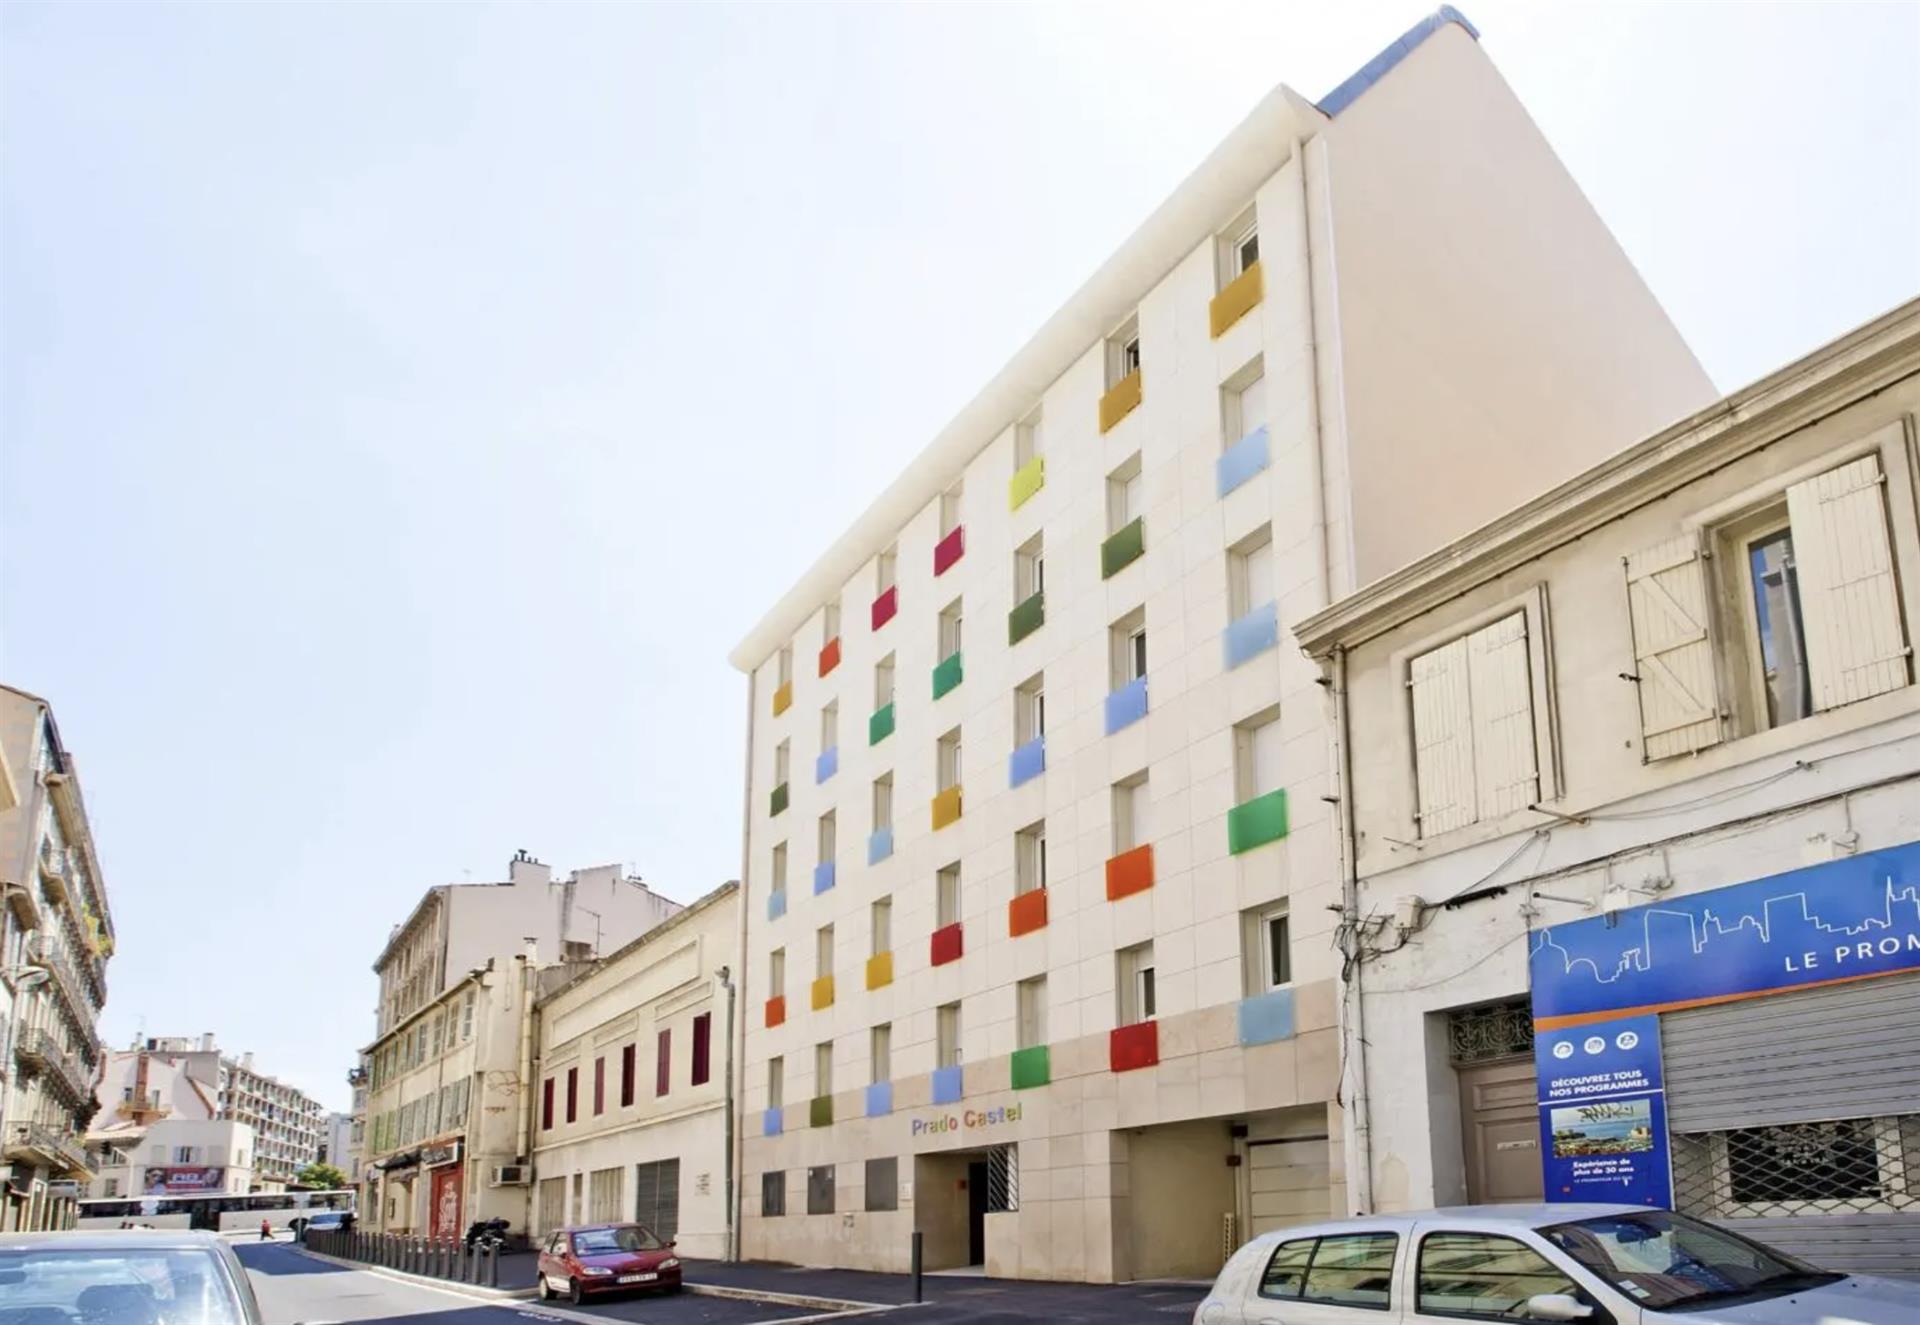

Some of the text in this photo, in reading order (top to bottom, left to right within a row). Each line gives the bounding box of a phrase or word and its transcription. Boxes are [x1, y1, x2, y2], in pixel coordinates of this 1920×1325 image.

[1785, 951, 1818, 972] LE
[1549, 1078, 1649, 1098] NOS PROGRAMMES
[1551, 1069, 1642, 1088] DÉCOUVREZ TOUS
[912, 1101, 1022, 1136] Prado Castel
[1573, 1159, 1618, 1169] Expérience
[1573, 1169, 1591, 1177] plus
